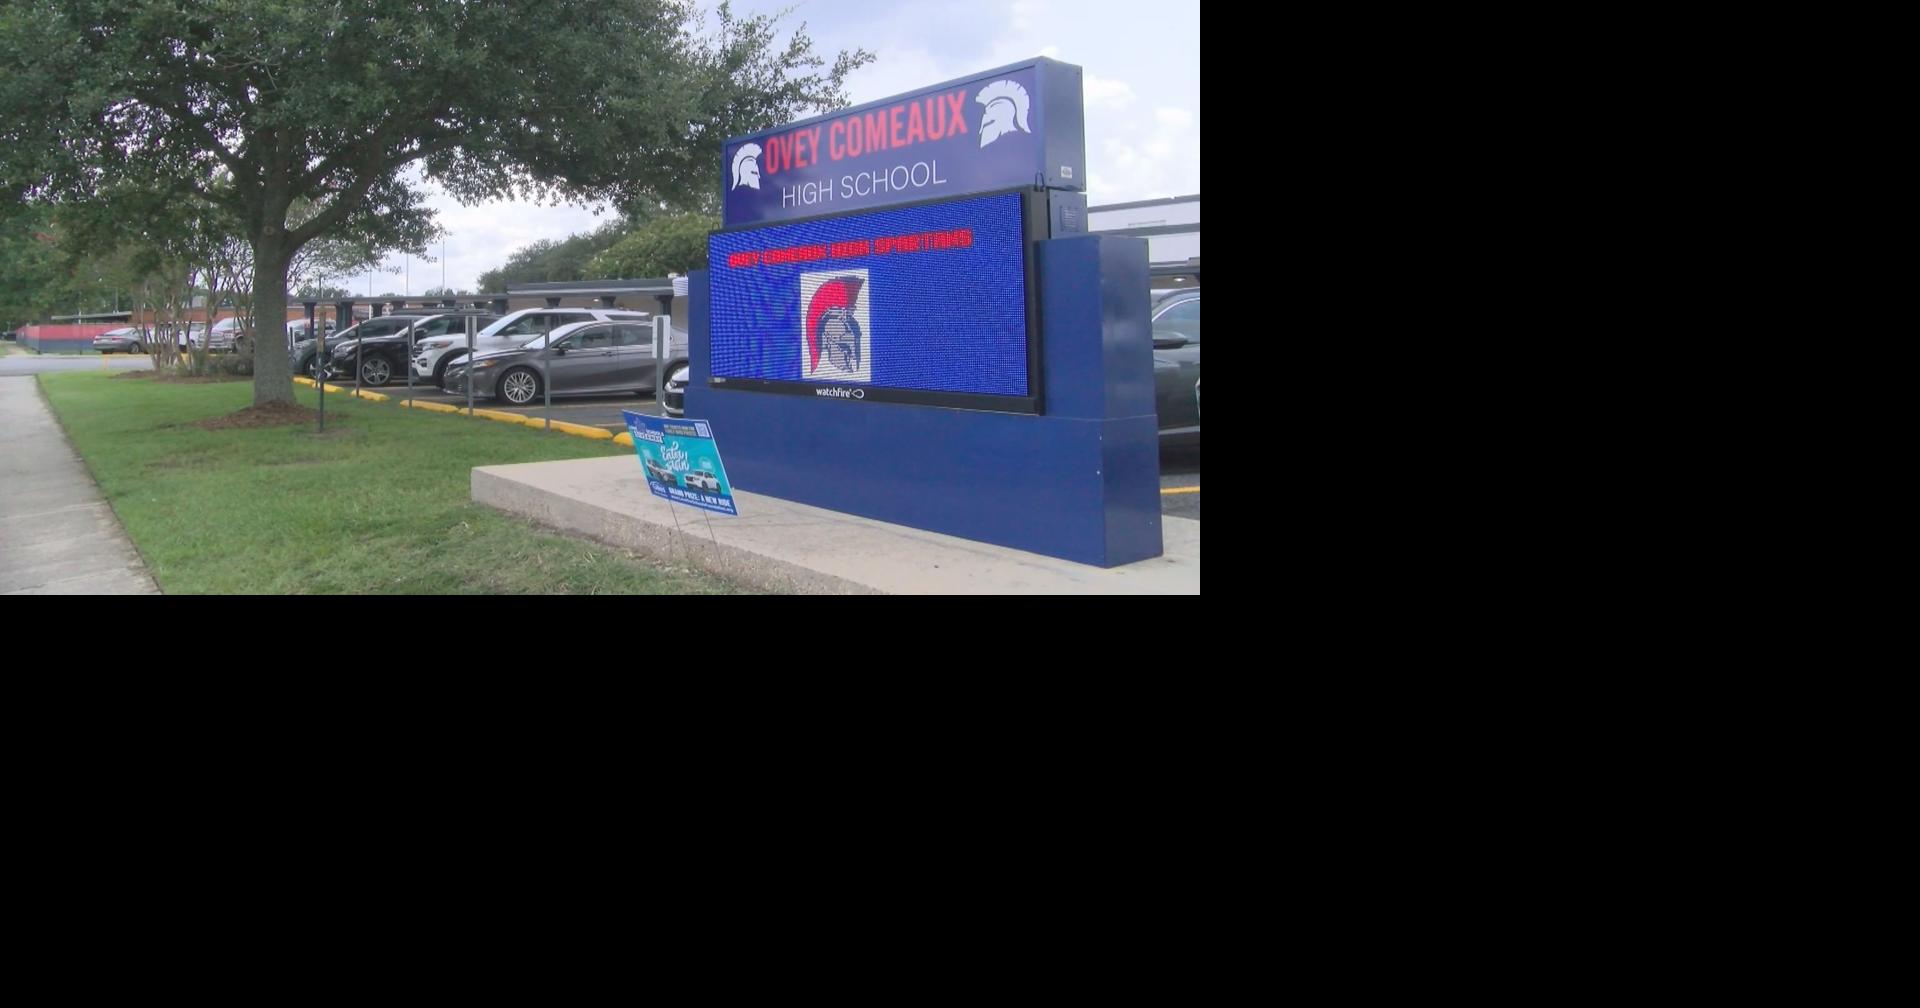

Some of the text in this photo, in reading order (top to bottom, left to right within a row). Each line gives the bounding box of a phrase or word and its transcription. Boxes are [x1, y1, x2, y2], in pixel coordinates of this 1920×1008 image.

[765, 90, 968, 175] OVEY COMEAUX
[782, 160, 947, 208] HIGH SCHOOL
[728, 228, 973, 268] OVEY COMEAUX HIGH SPARTANS
[816, 387, 850, 398] watchfire
